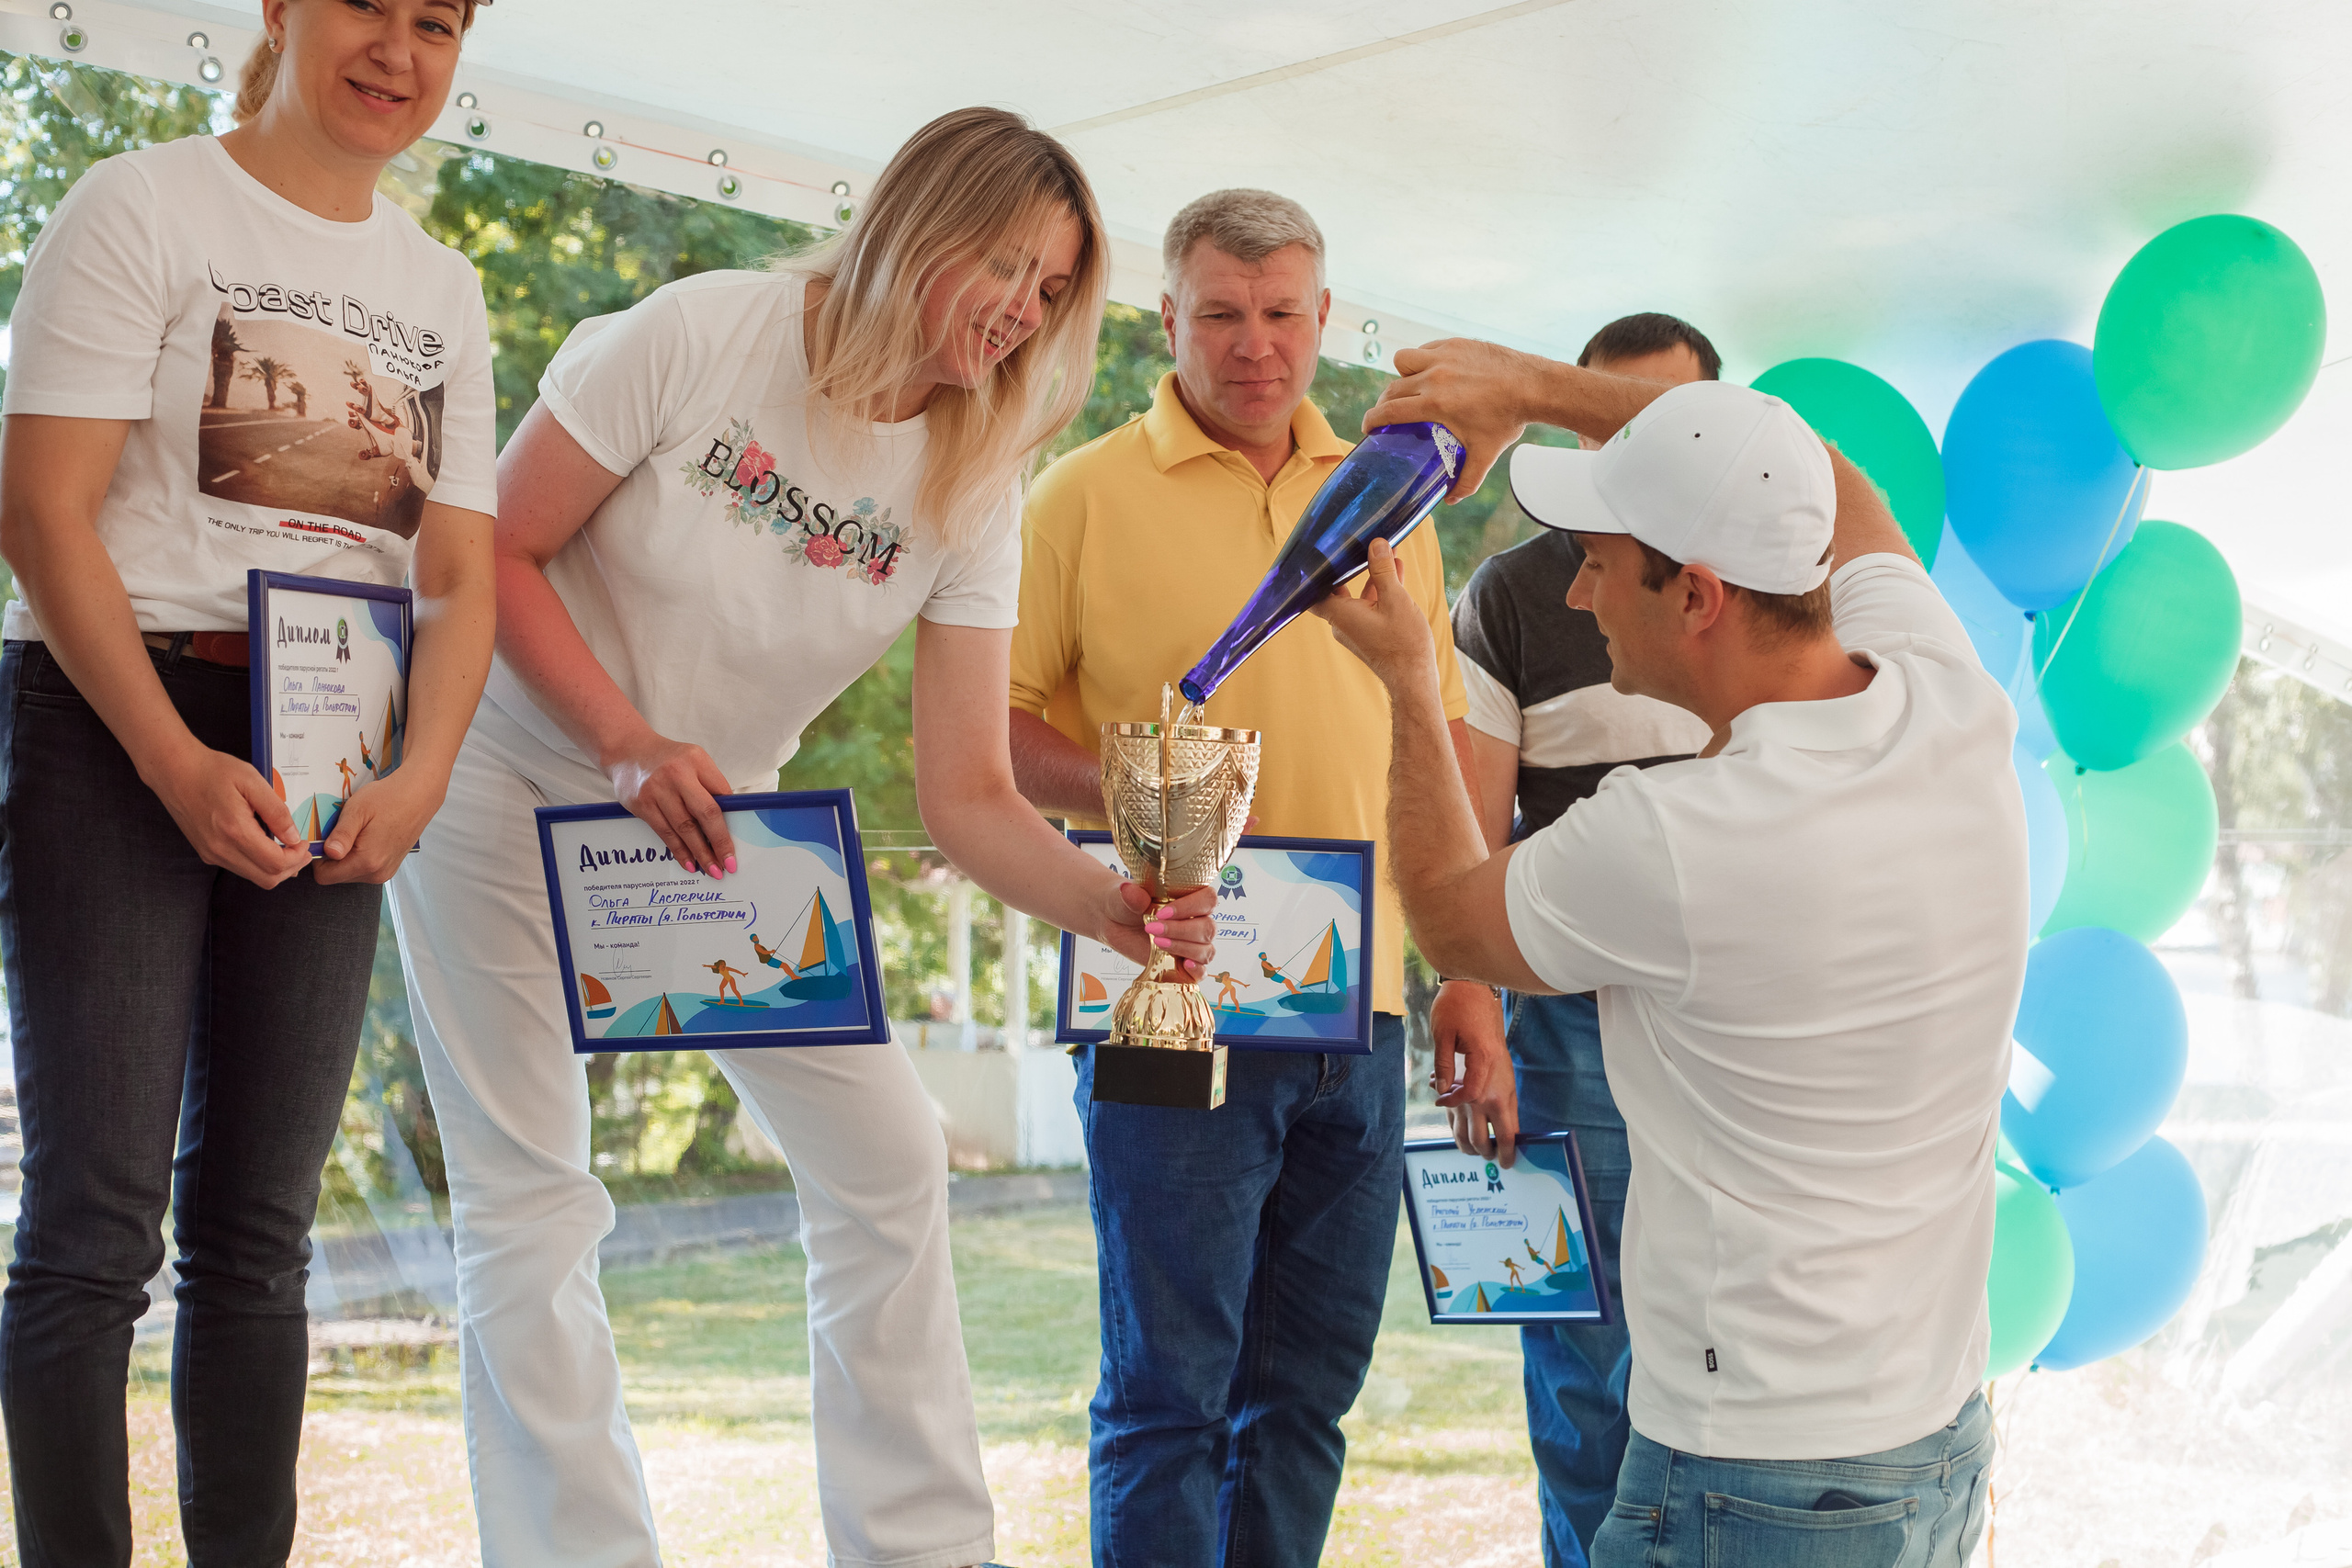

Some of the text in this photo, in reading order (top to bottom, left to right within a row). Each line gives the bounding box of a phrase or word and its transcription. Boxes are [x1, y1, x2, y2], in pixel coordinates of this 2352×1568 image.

[343, 294, 445, 357] Drive
[698, 438, 901, 575] BLOSSOM
[208, 516, 223, 527] THE
[224, 522, 246, 533] ONLY
[248, 527, 264, 536] TRIP
[266, 530, 280, 538] YOU
[282, 532, 300, 541] WILL
[302, 536, 334, 545] REGRET
[288, 518, 362, 541] ON THE ROAD
[277, 615, 331, 649] Диплом
[583, 883, 622, 891] победителя
[623, 881, 654, 890] парусной
[655, 880, 678, 888] регаты
[589, 894, 629, 908] Ольга
[610, 941, 639, 949] команда!
[1422, 1168, 1479, 1189] Диплом
